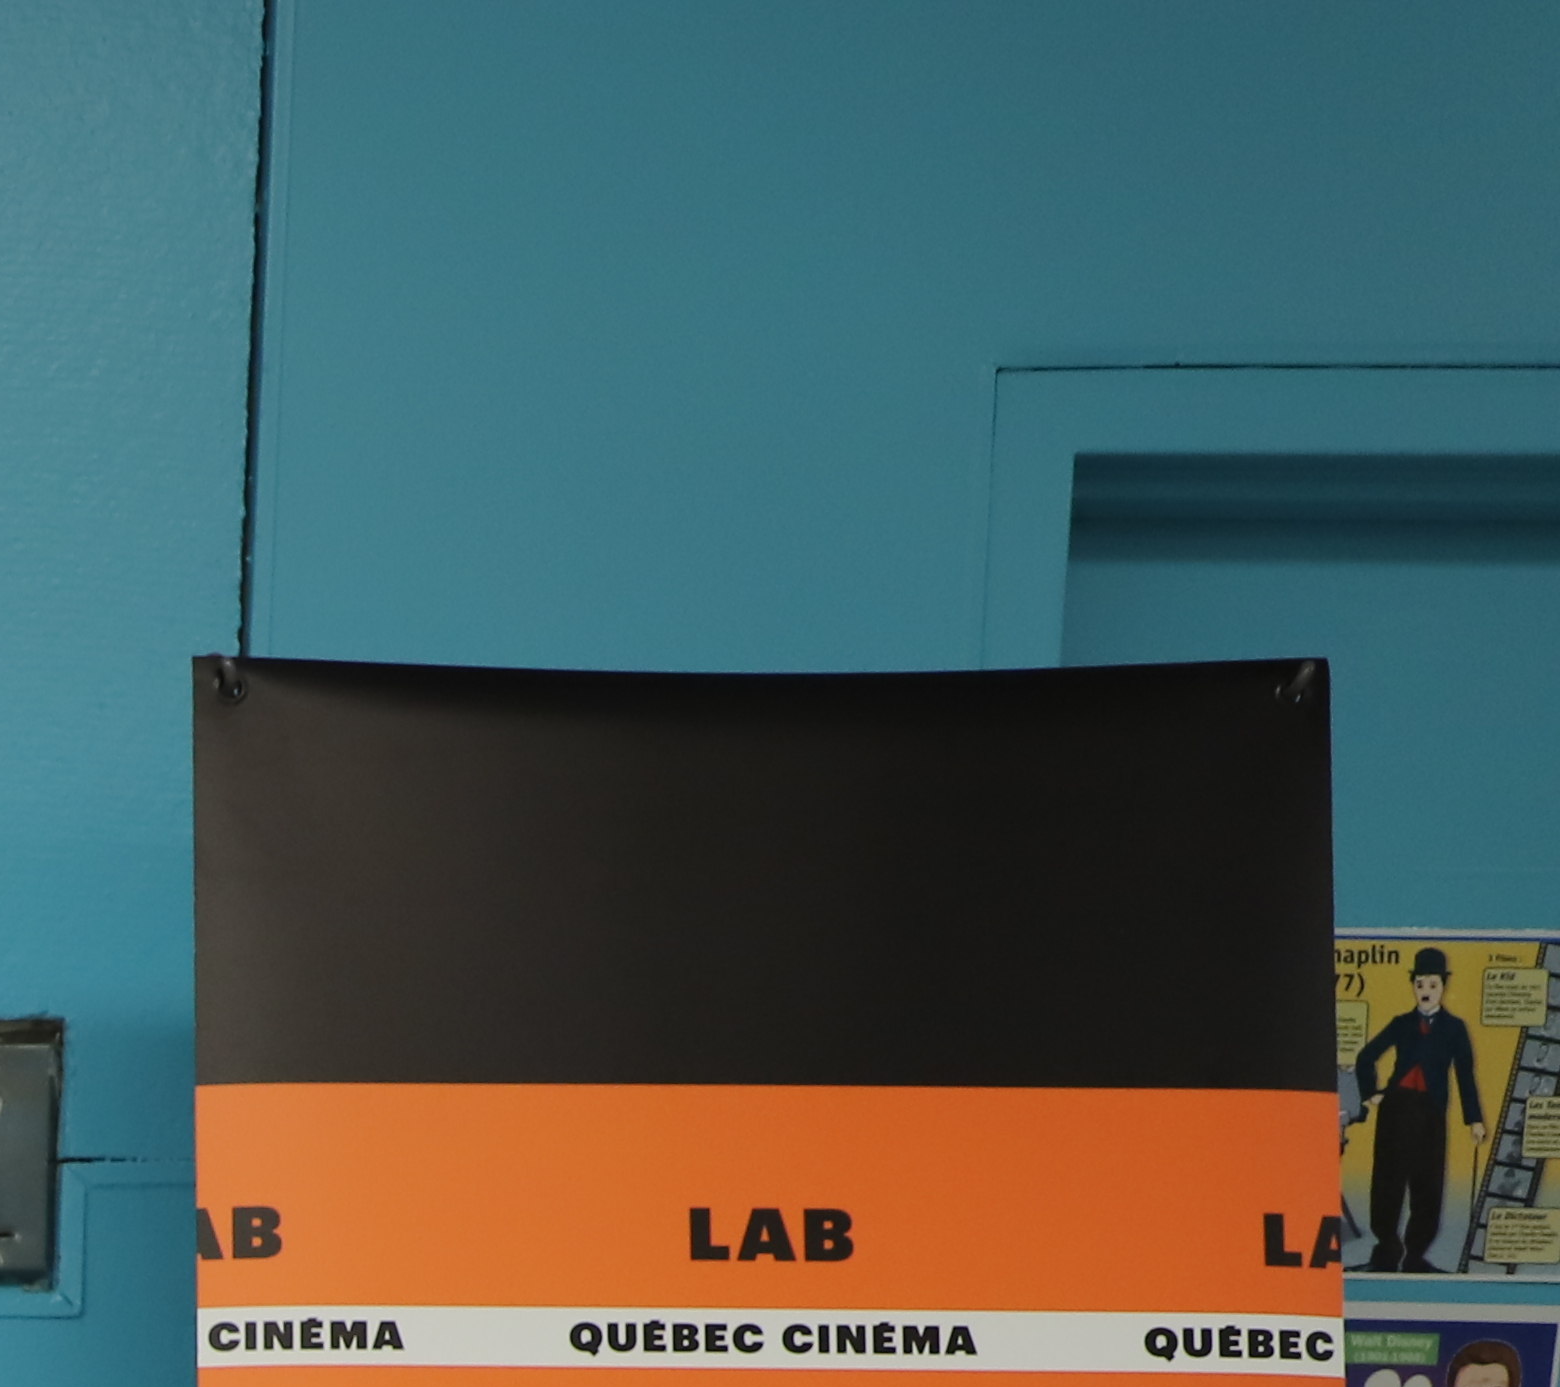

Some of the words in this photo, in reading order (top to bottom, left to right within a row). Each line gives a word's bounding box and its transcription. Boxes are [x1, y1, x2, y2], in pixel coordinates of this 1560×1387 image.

[196, 1207, 280, 1259] AB
[690, 1207, 853, 1261] LAB
[1264, 1212, 1342, 1268] LA
[208, 1317, 403, 1351] CINÉMA
[569, 1319, 764, 1356] QUÉBEC
[782, 1321, 977, 1355] CINÉMA
[1144, 1324, 1334, 1362] QUÉBEC
